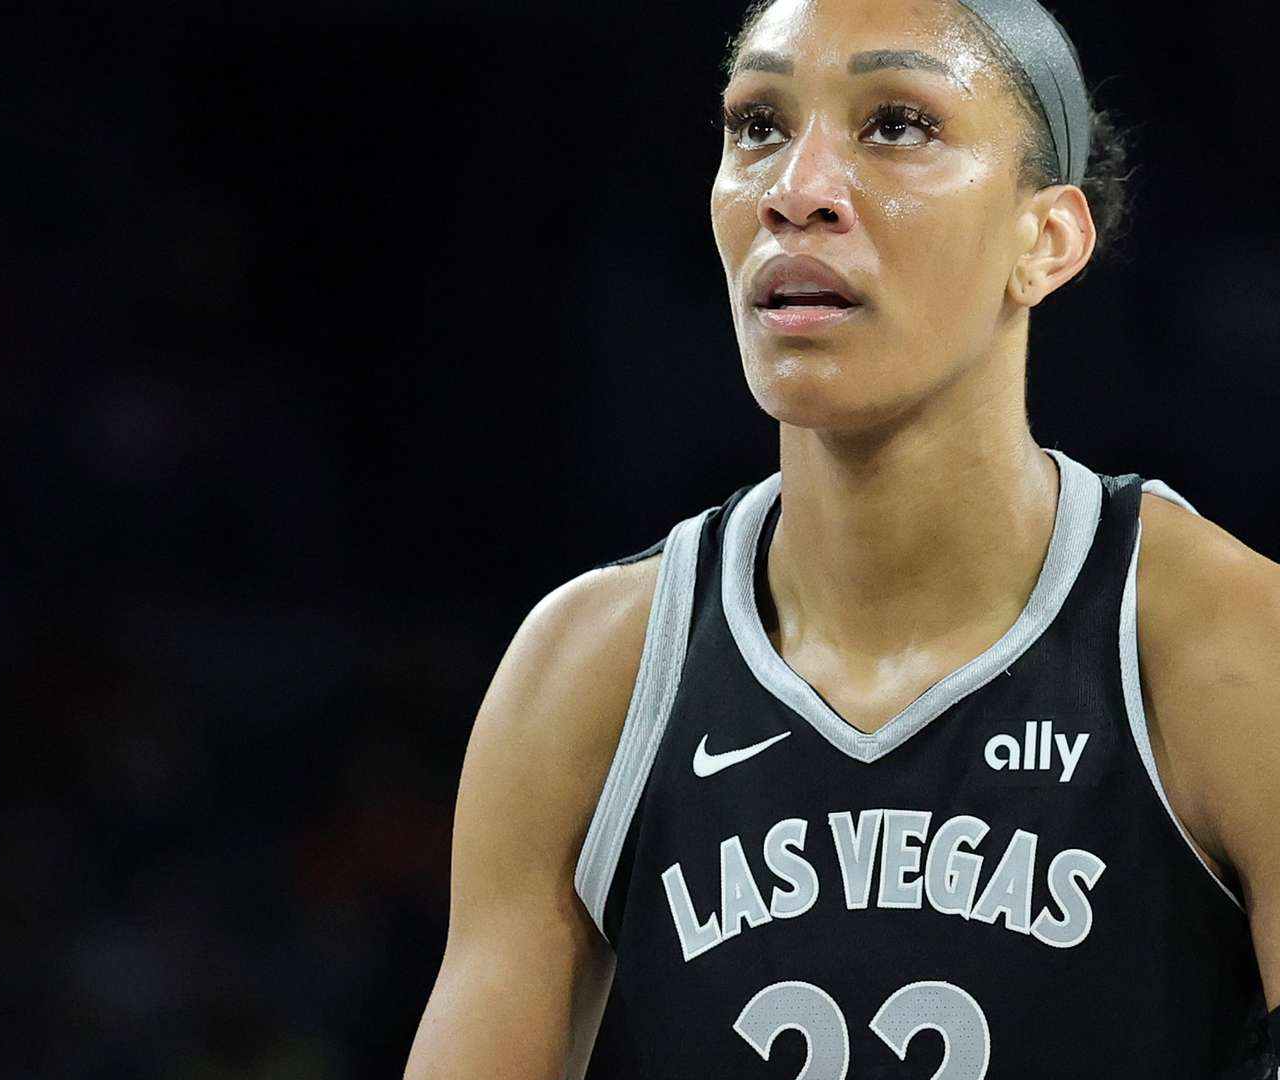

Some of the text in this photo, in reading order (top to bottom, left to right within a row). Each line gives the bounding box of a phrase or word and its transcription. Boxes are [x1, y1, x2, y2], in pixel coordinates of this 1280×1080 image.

[984, 720, 1090, 783] ally
[660, 808, 1107, 963] LAS VEGAS
